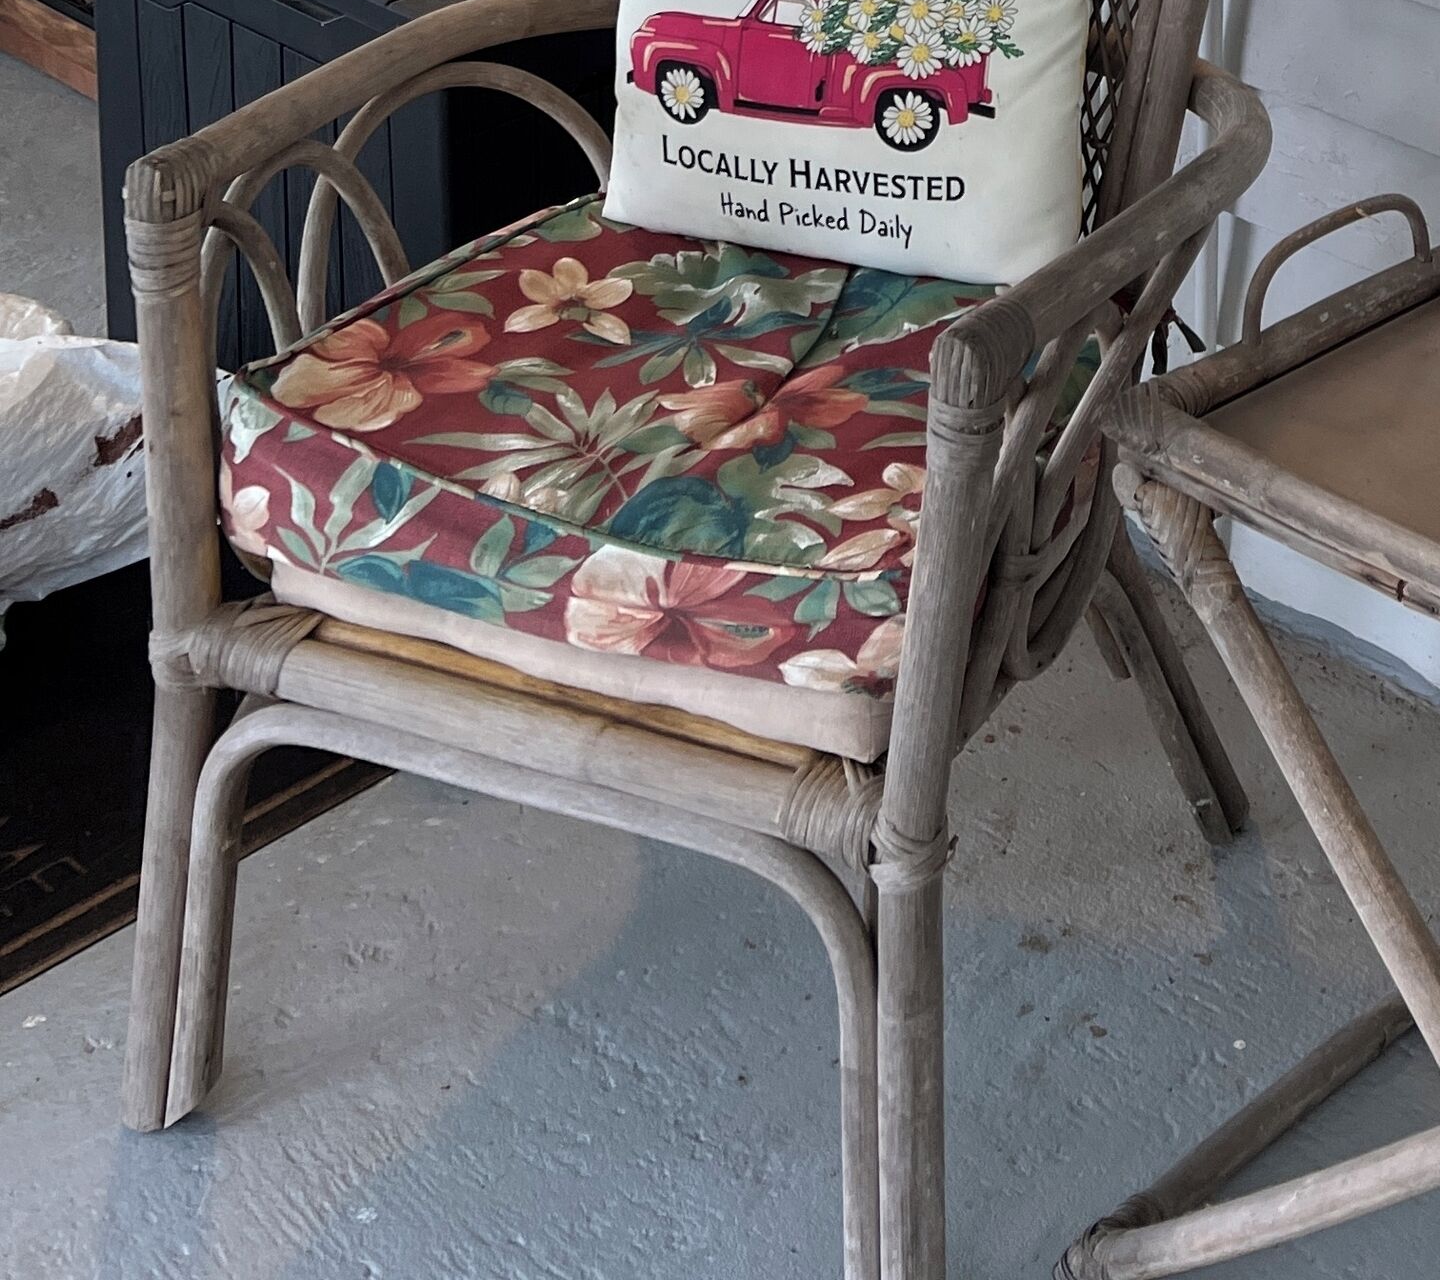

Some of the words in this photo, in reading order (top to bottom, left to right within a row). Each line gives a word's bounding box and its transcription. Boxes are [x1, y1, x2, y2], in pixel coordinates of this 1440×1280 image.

[662, 134, 779, 186] LOCALLY
[788, 158, 966, 202] HARVESTED
[720, 191, 770, 223] Hand
[778, 201, 850, 231] Picked
[858, 209, 913, 250] Daily
